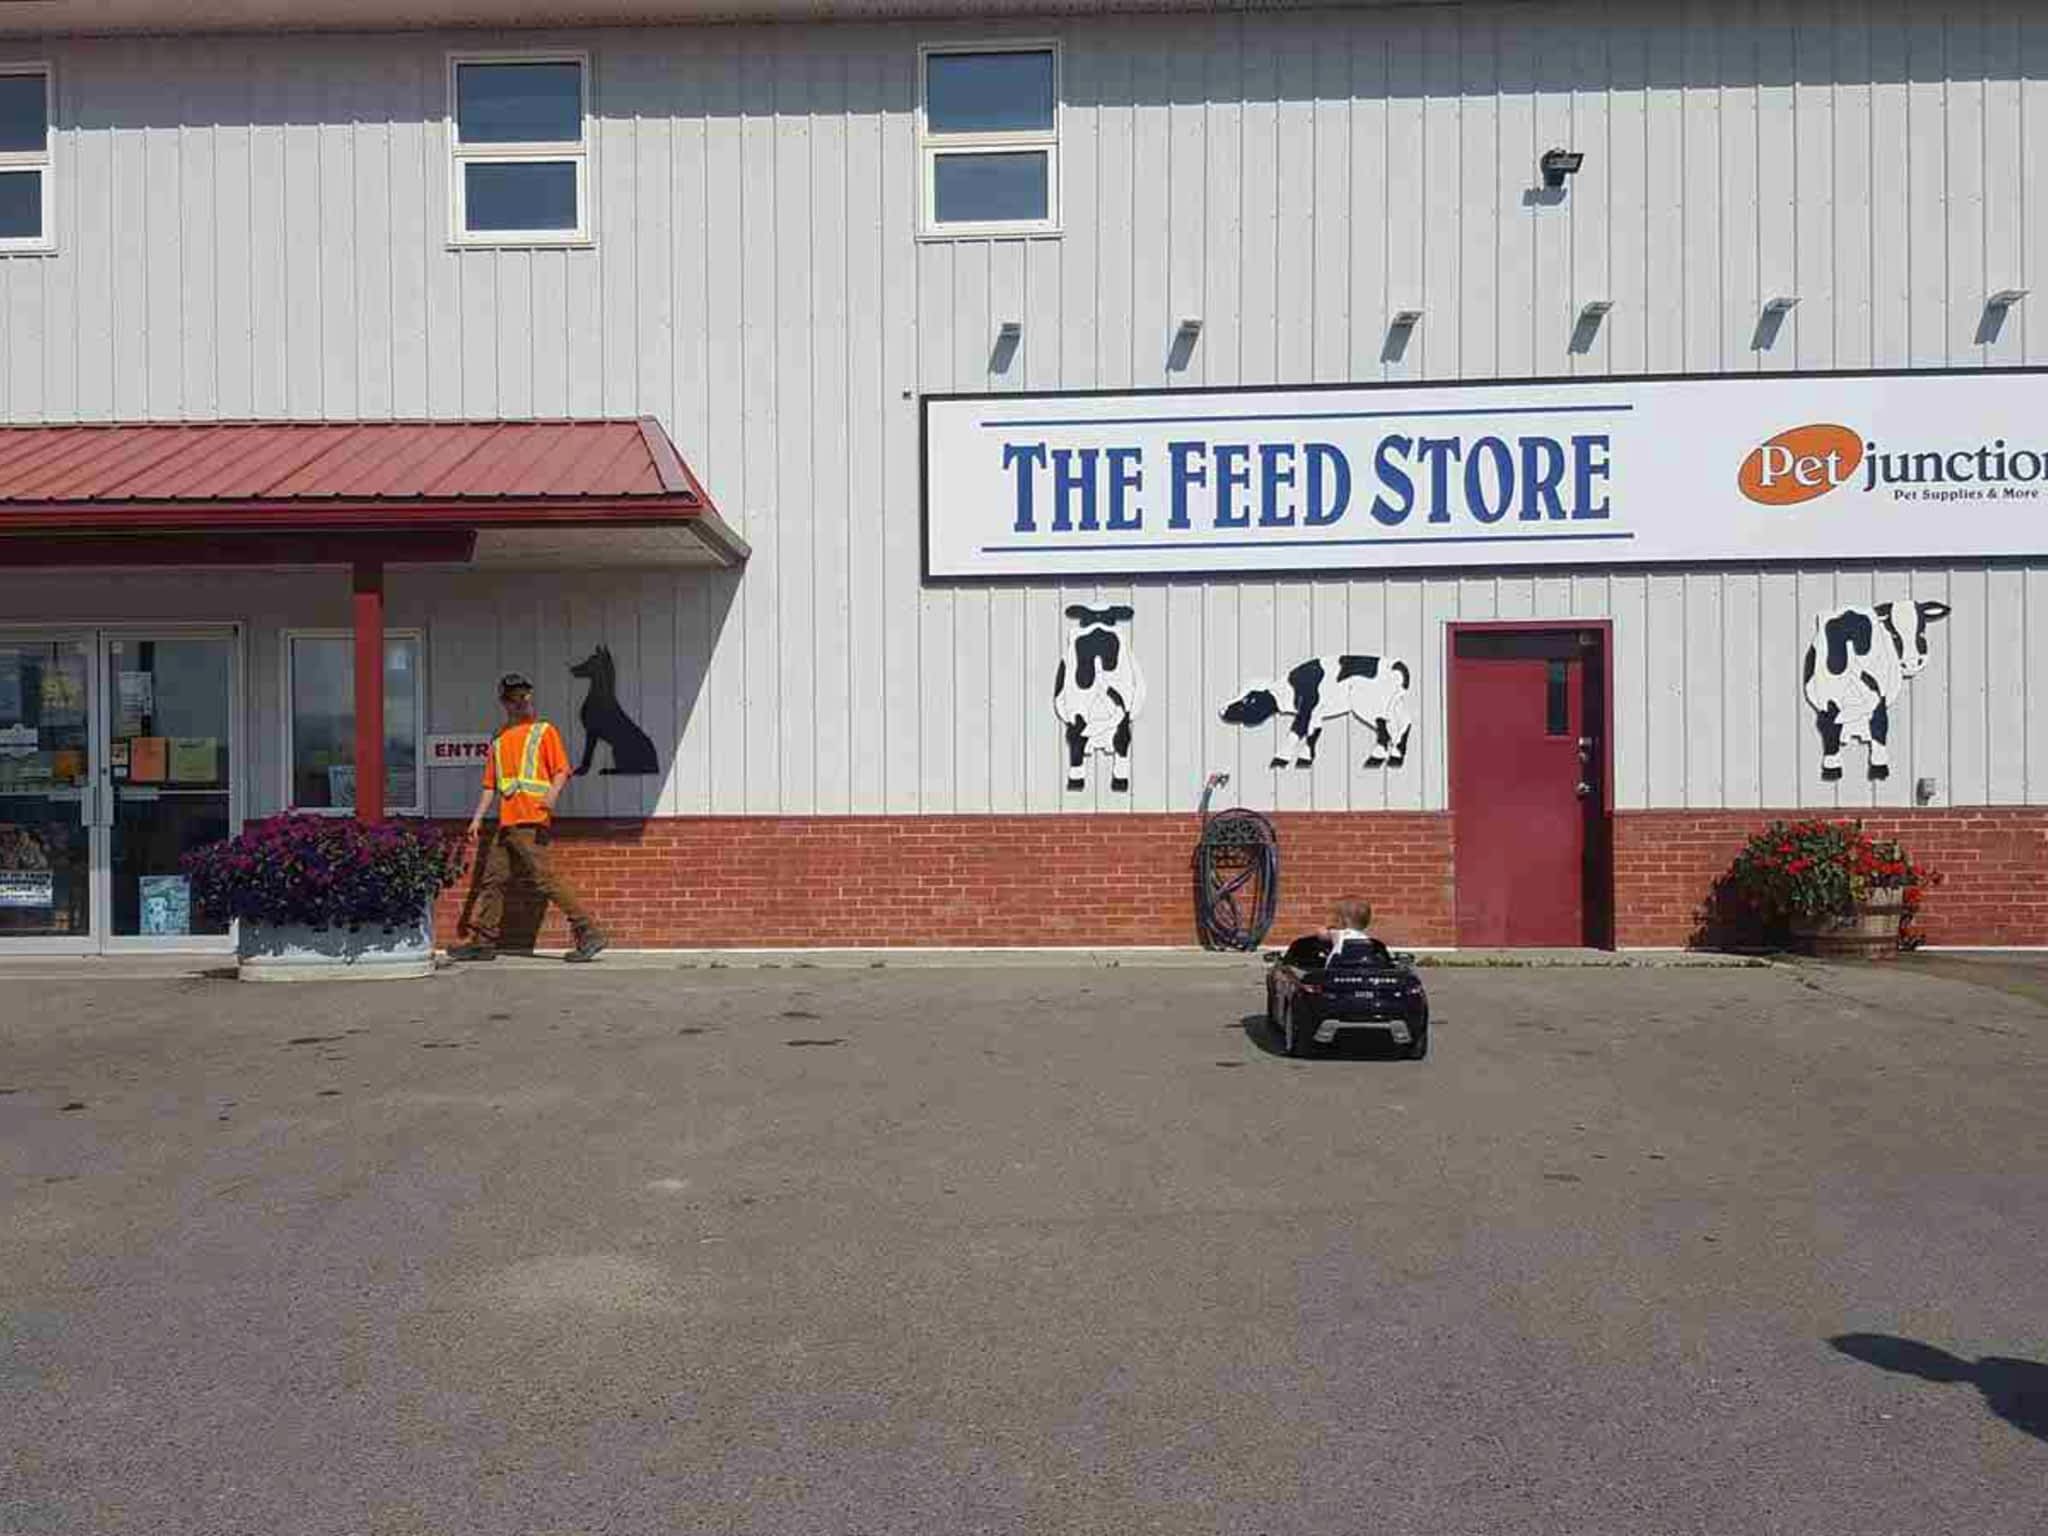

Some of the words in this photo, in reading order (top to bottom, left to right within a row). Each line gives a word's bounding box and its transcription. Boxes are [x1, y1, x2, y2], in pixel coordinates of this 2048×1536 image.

[1759, 445, 1843, 487] Pet
[1862, 439, 2048, 492] junctio
[1003, 442, 1143, 532] THE
[1167, 441, 1352, 529] FEED
[1370, 434, 1610, 527] STORE
[1894, 489, 1917, 501] Pet
[1922, 488, 1983, 502] Supplies
[1986, 488, 1997, 500] &
[2002, 488, 2039, 500] More
[434, 743, 489, 758] ENTR
